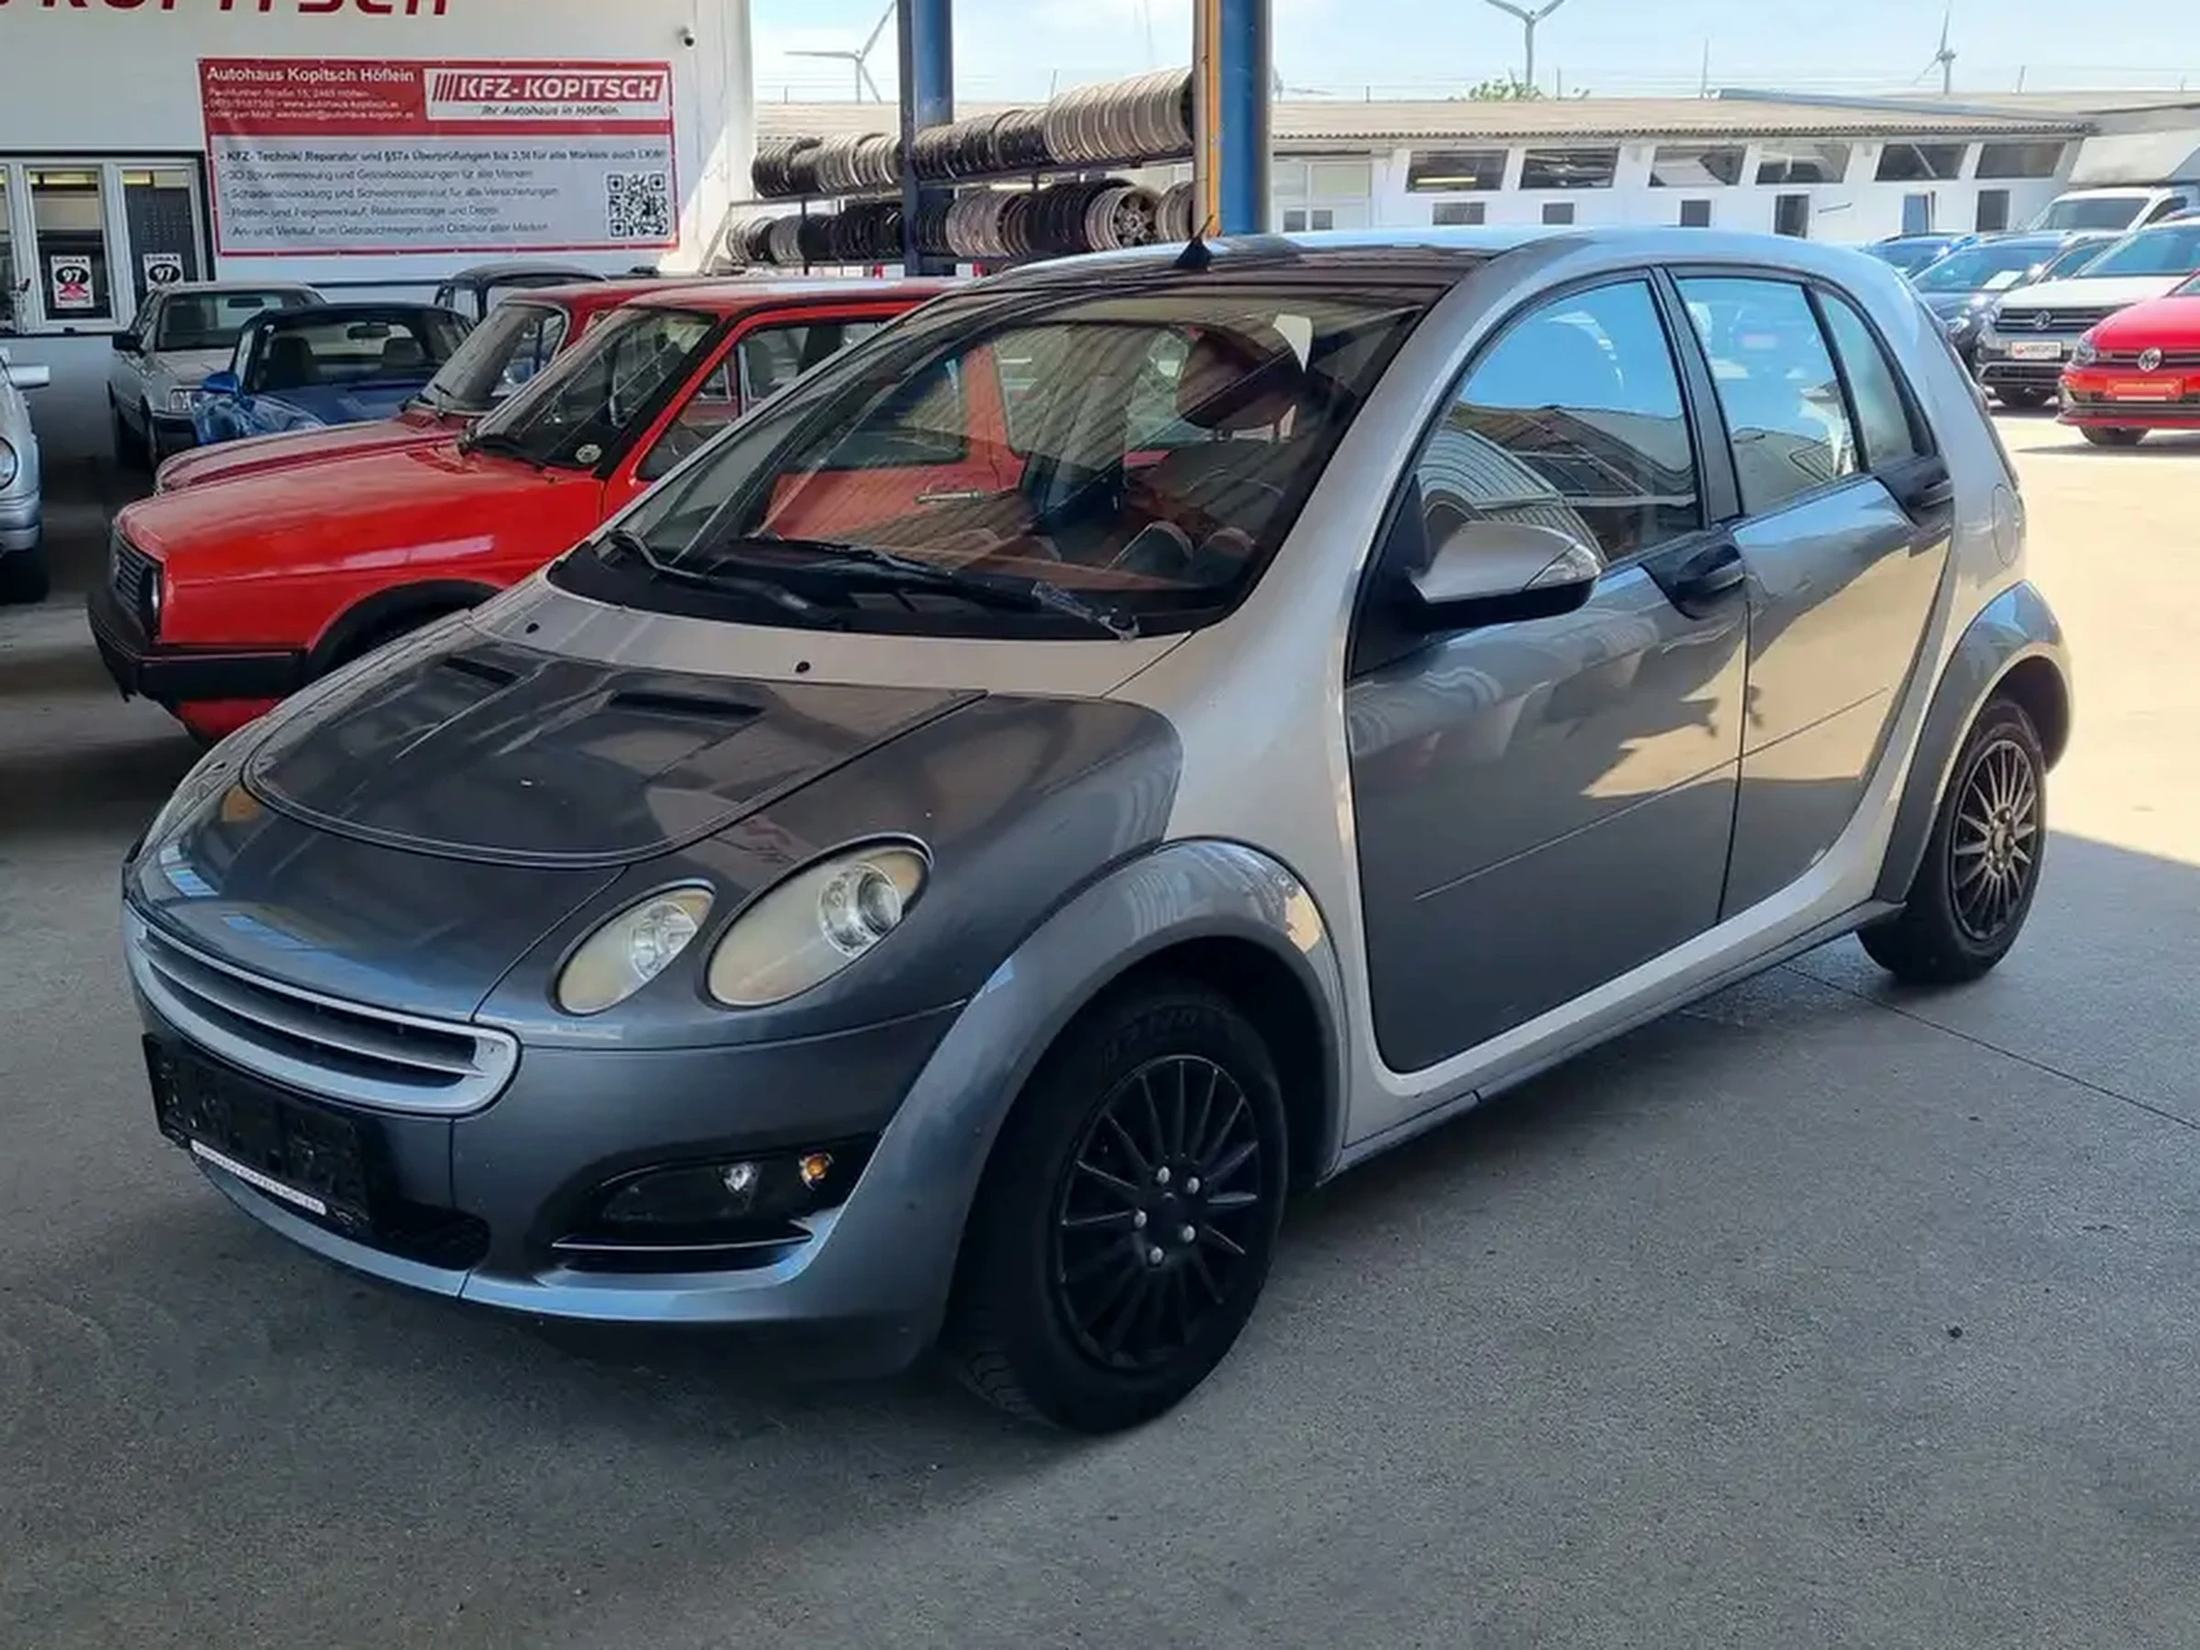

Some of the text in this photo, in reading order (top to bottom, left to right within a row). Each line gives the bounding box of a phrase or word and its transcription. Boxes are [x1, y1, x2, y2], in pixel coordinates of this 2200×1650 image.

[207, 65, 414, 85] Autohaus Kopitsch Höflein
[481, 104, 497, 116] Ihr
[501, 104, 558, 117] Autohaus
[561, 105, 572, 115] in
[305, 150, 358, 163] Reparatur
[361, 150, 382, 161] und
[494, 149, 508, 160] bis
[533, 149, 547, 160] für
[549, 149, 566, 159] alle
[611, 149, 634, 159] auch
[335, 169, 354, 180] und
[461, 168, 476, 179] für
[478, 168, 493, 178] alle
[335, 188, 354, 199] und
[448, 186, 462, 197] für
[465, 186, 482, 196] alle
[271, 207, 291, 218] und
[448, 205, 467, 215] und
[253, 225, 274, 236] und
[338, 223, 424, 238] Gebrauchtwagen
[62, 268, 82, 282] 97
[154, 266, 173, 281] 97
